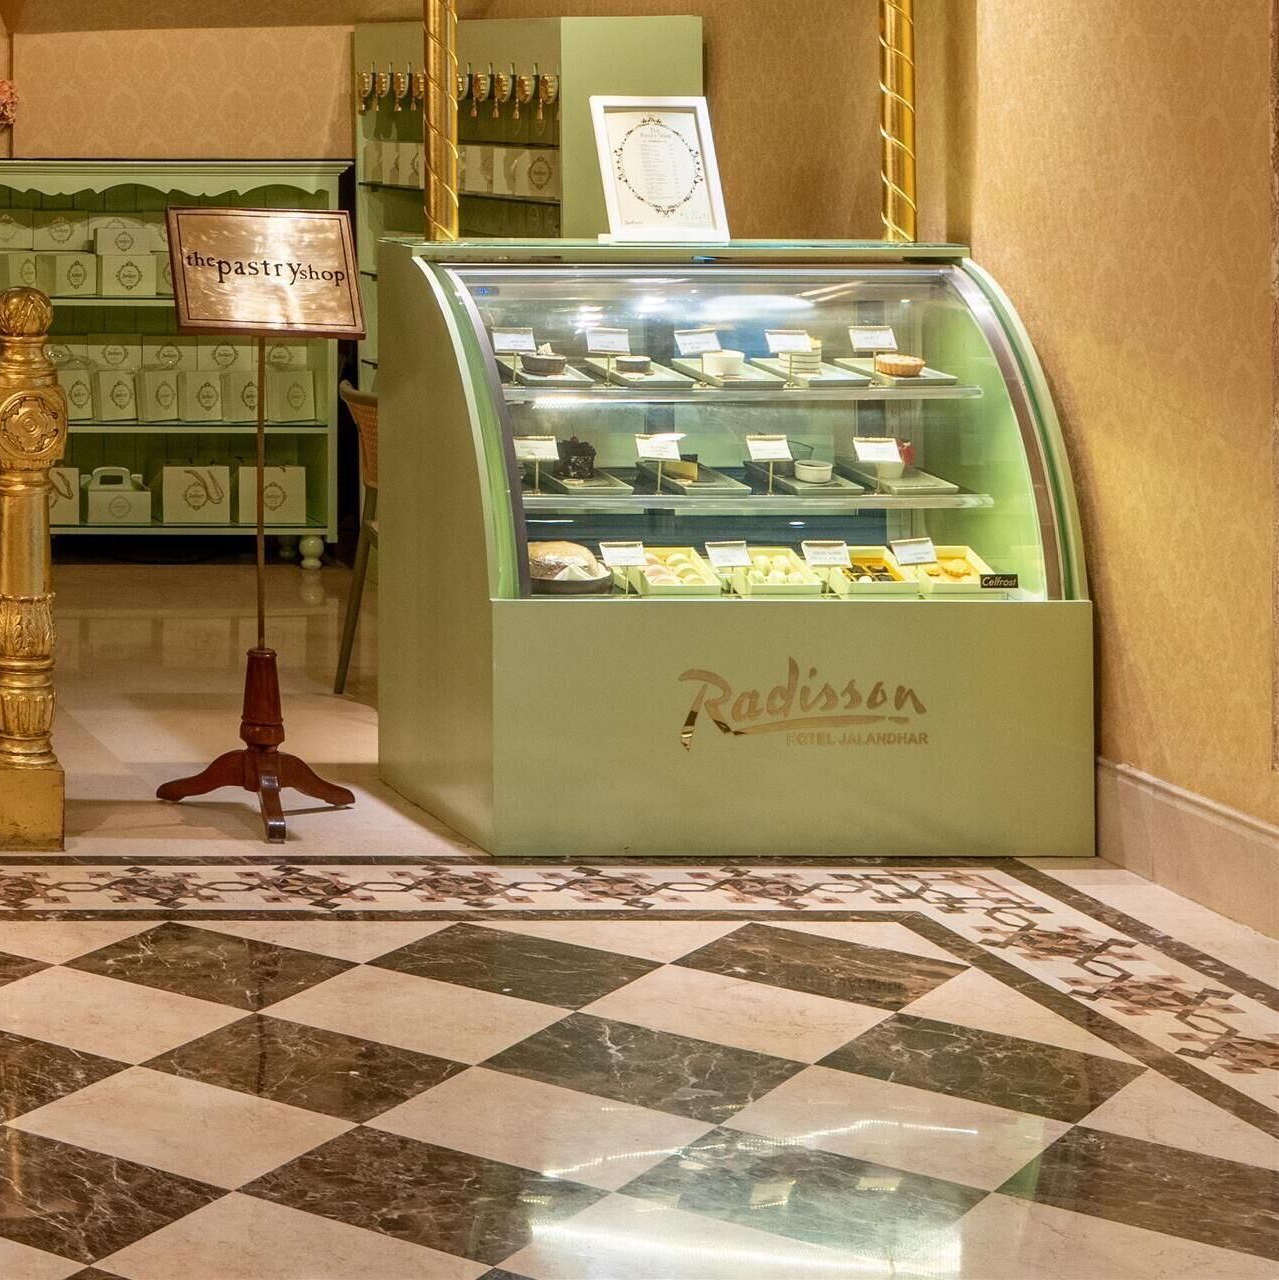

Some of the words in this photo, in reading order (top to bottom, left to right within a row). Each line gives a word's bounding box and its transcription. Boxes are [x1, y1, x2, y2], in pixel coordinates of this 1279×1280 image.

[216, 259, 302, 286] pastry
[299, 264, 345, 287] shop
[982, 576, 1017, 587] Celfrost
[678, 656, 927, 752] Radisson
